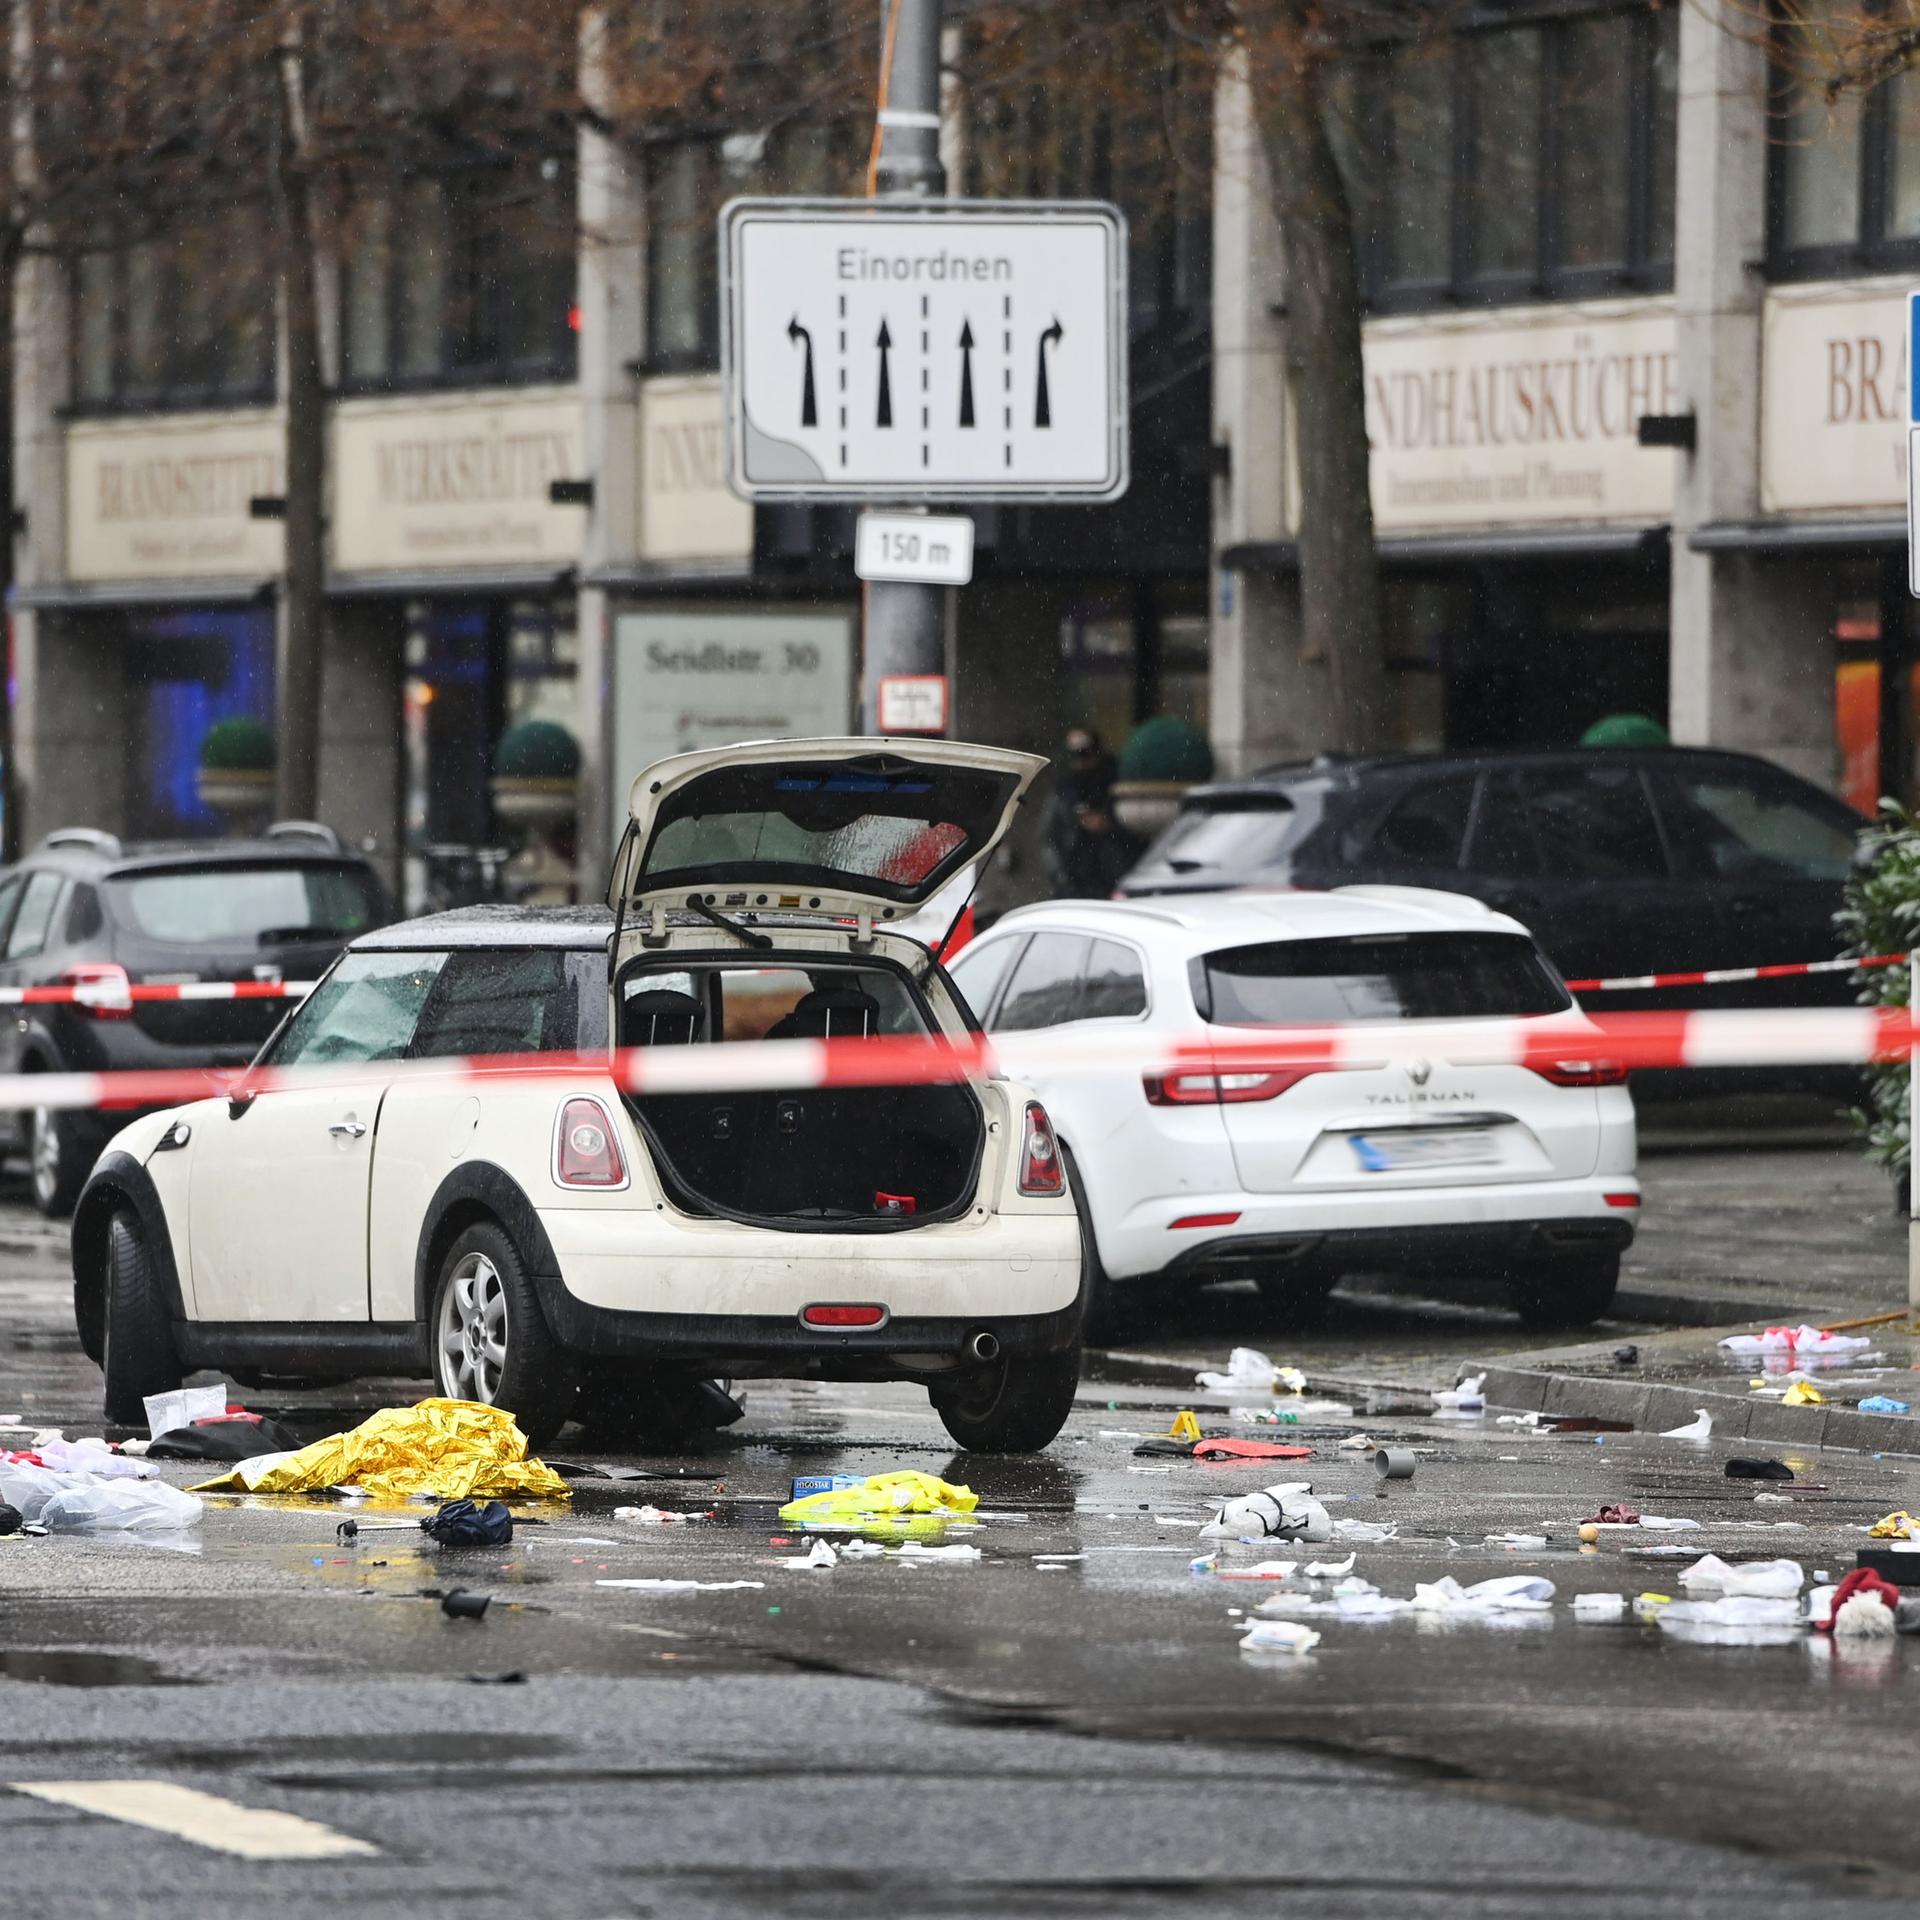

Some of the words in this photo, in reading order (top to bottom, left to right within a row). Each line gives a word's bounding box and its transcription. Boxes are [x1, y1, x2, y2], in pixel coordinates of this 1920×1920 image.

[837, 249, 1013, 281] Einordnen
[879, 533, 922, 563] 150
[928, 541, 951, 567] m
[1366, 1091, 1476, 1105] TALISMAN
